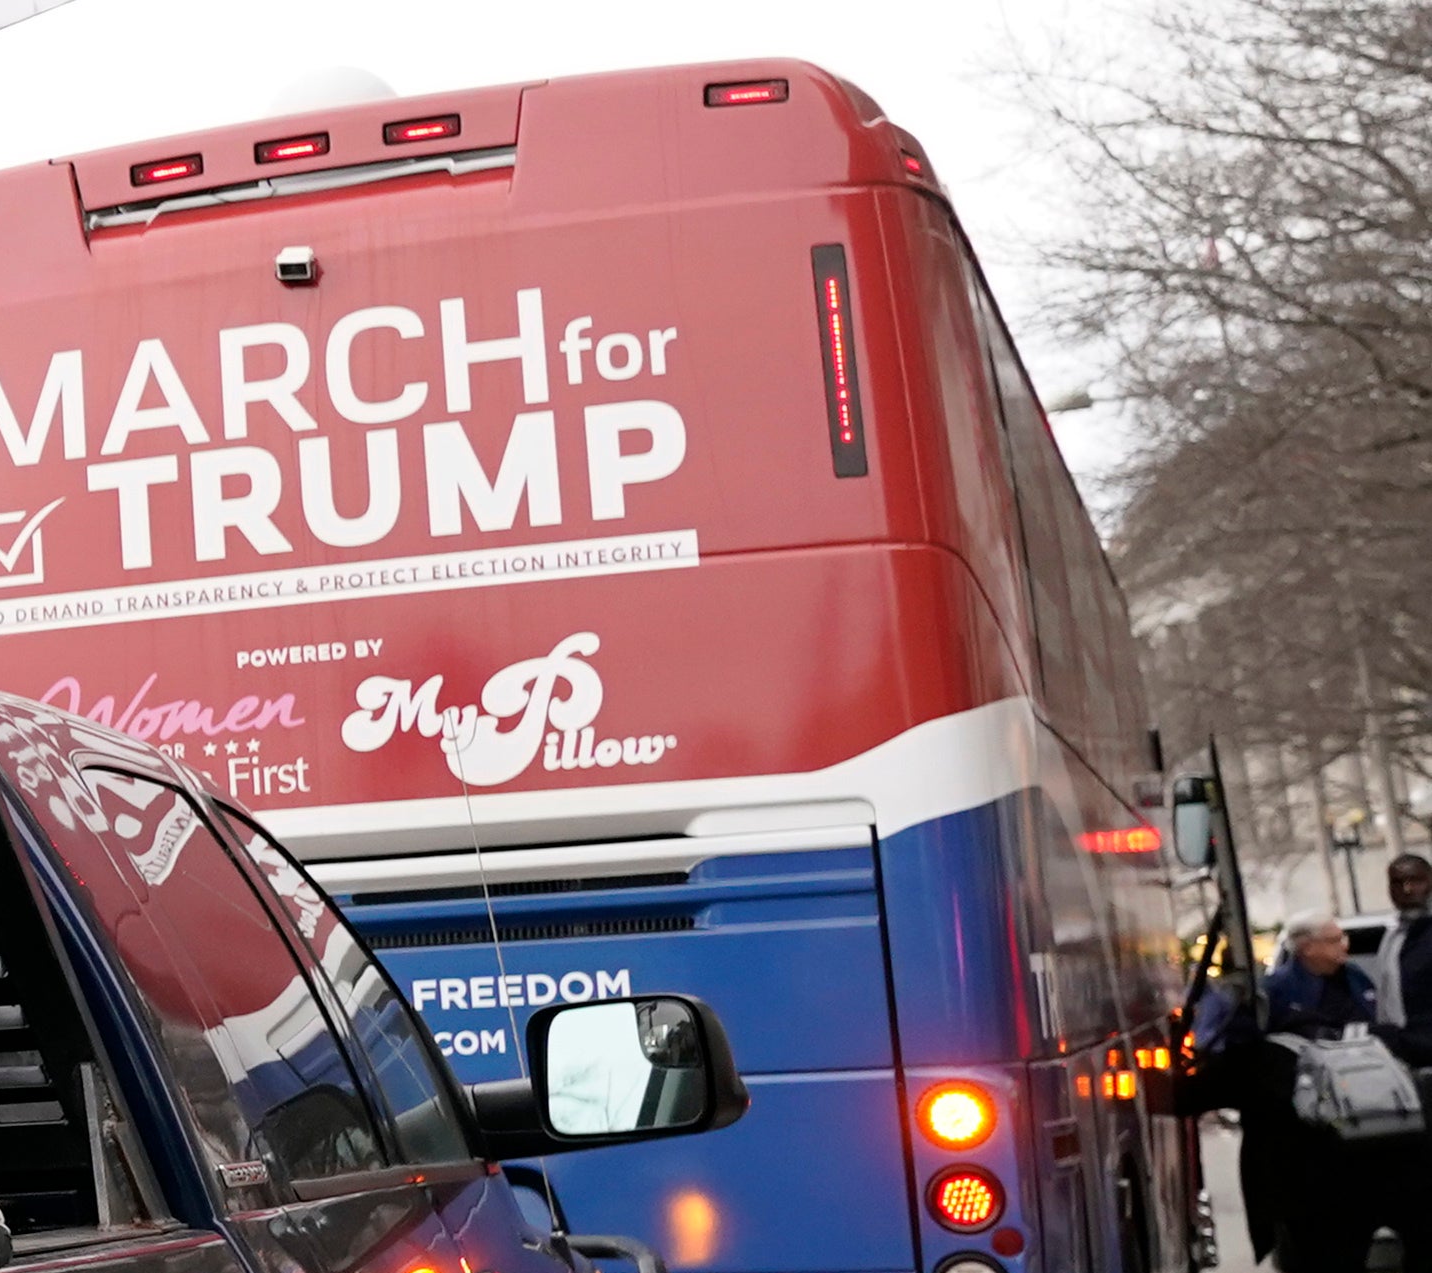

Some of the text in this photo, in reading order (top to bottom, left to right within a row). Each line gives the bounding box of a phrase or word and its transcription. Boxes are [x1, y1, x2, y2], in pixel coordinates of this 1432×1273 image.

[559, 316, 678, 387] for
[87, 399, 687, 570] TRUMP
[14, 600, 105, 624] DEMAND
[114, 580, 284, 614] TRANSPARENCY
[296, 577, 308, 593] &
[320, 564, 422, 591] PROTECT
[431, 554, 545, 581] ELECTION
[556, 540, 684, 570] INTEGRITY
[237, 639, 383, 668] POWERED BY
[41, 673, 305, 741] Women
[228, 757, 311, 796] First
[412, 970, 630, 1012] FREEDOM
